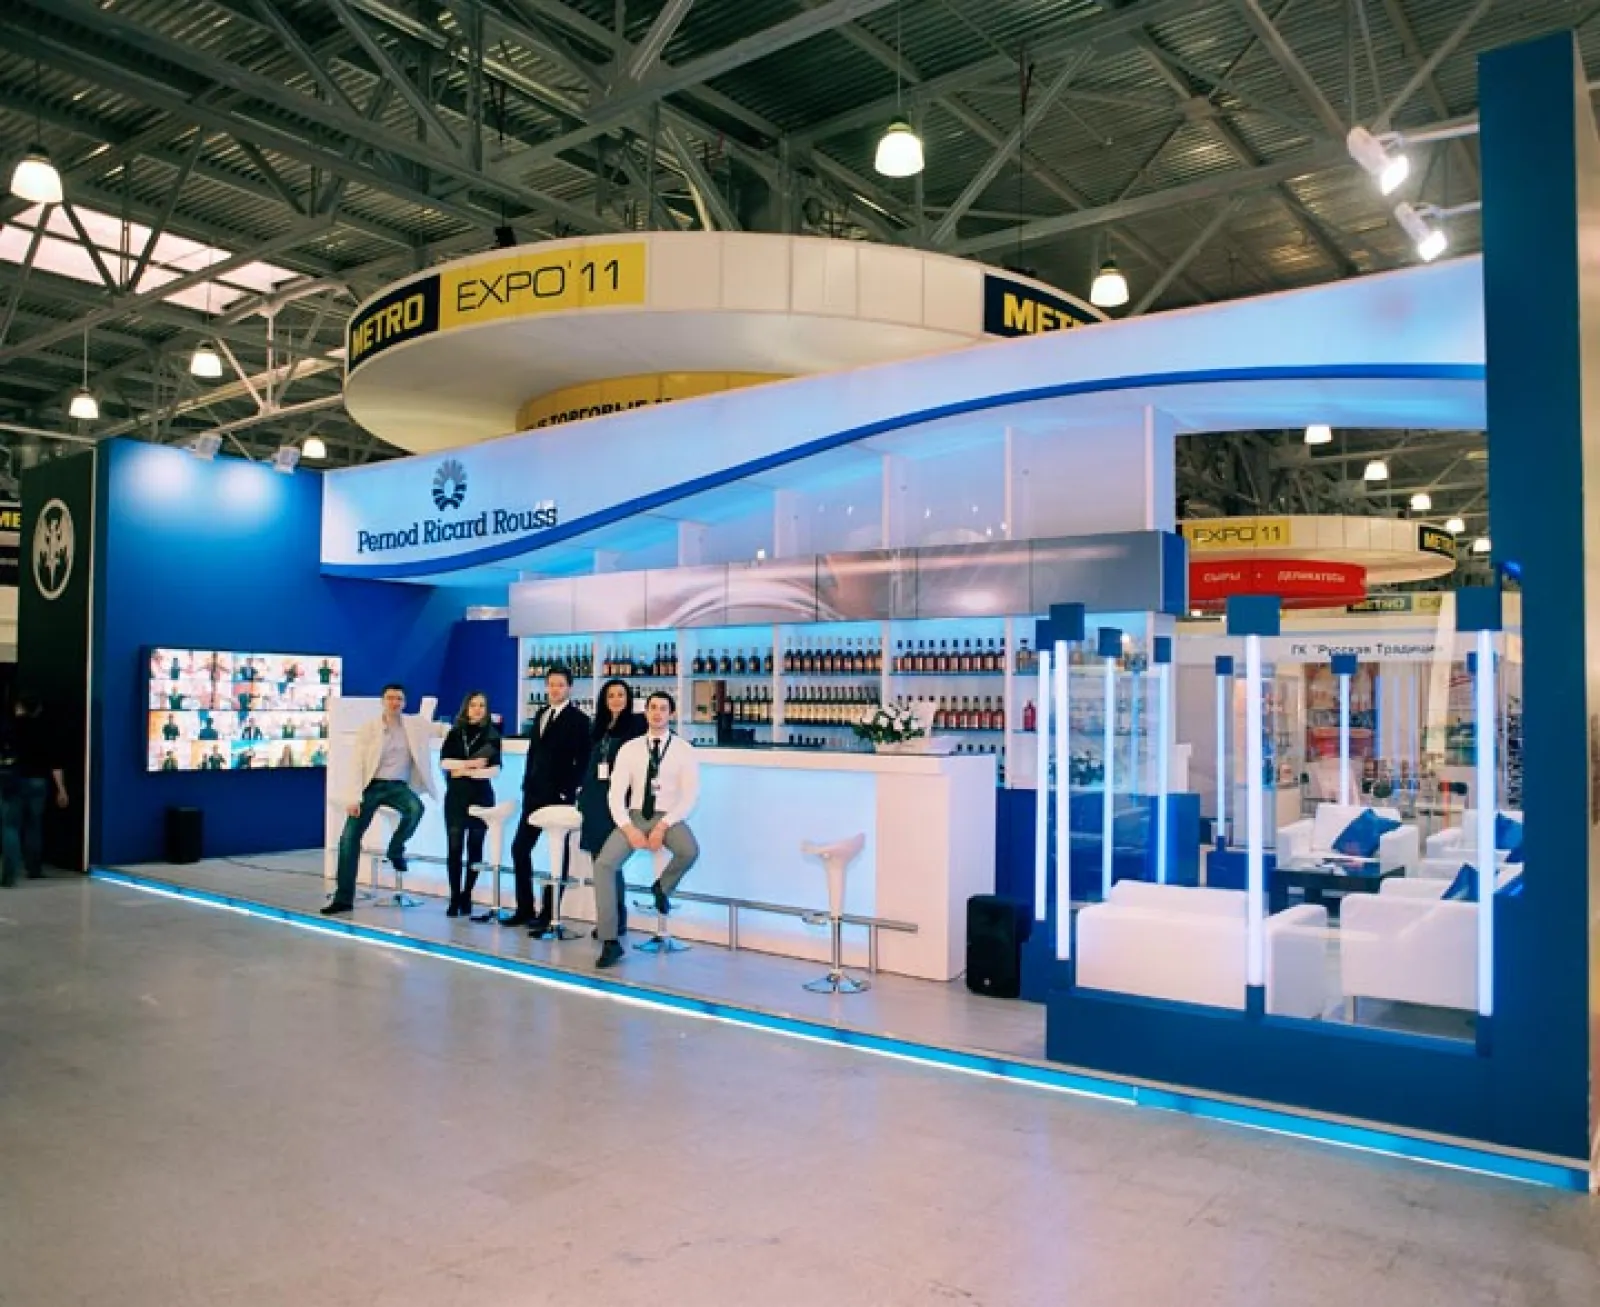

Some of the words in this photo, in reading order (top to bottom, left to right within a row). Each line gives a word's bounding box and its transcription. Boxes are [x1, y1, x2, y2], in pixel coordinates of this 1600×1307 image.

[352, 292, 425, 361] METRO
[357, 522, 418, 553] Pernod
[423, 512, 488, 544] Ricard
[493, 507, 558, 535] Rouss
